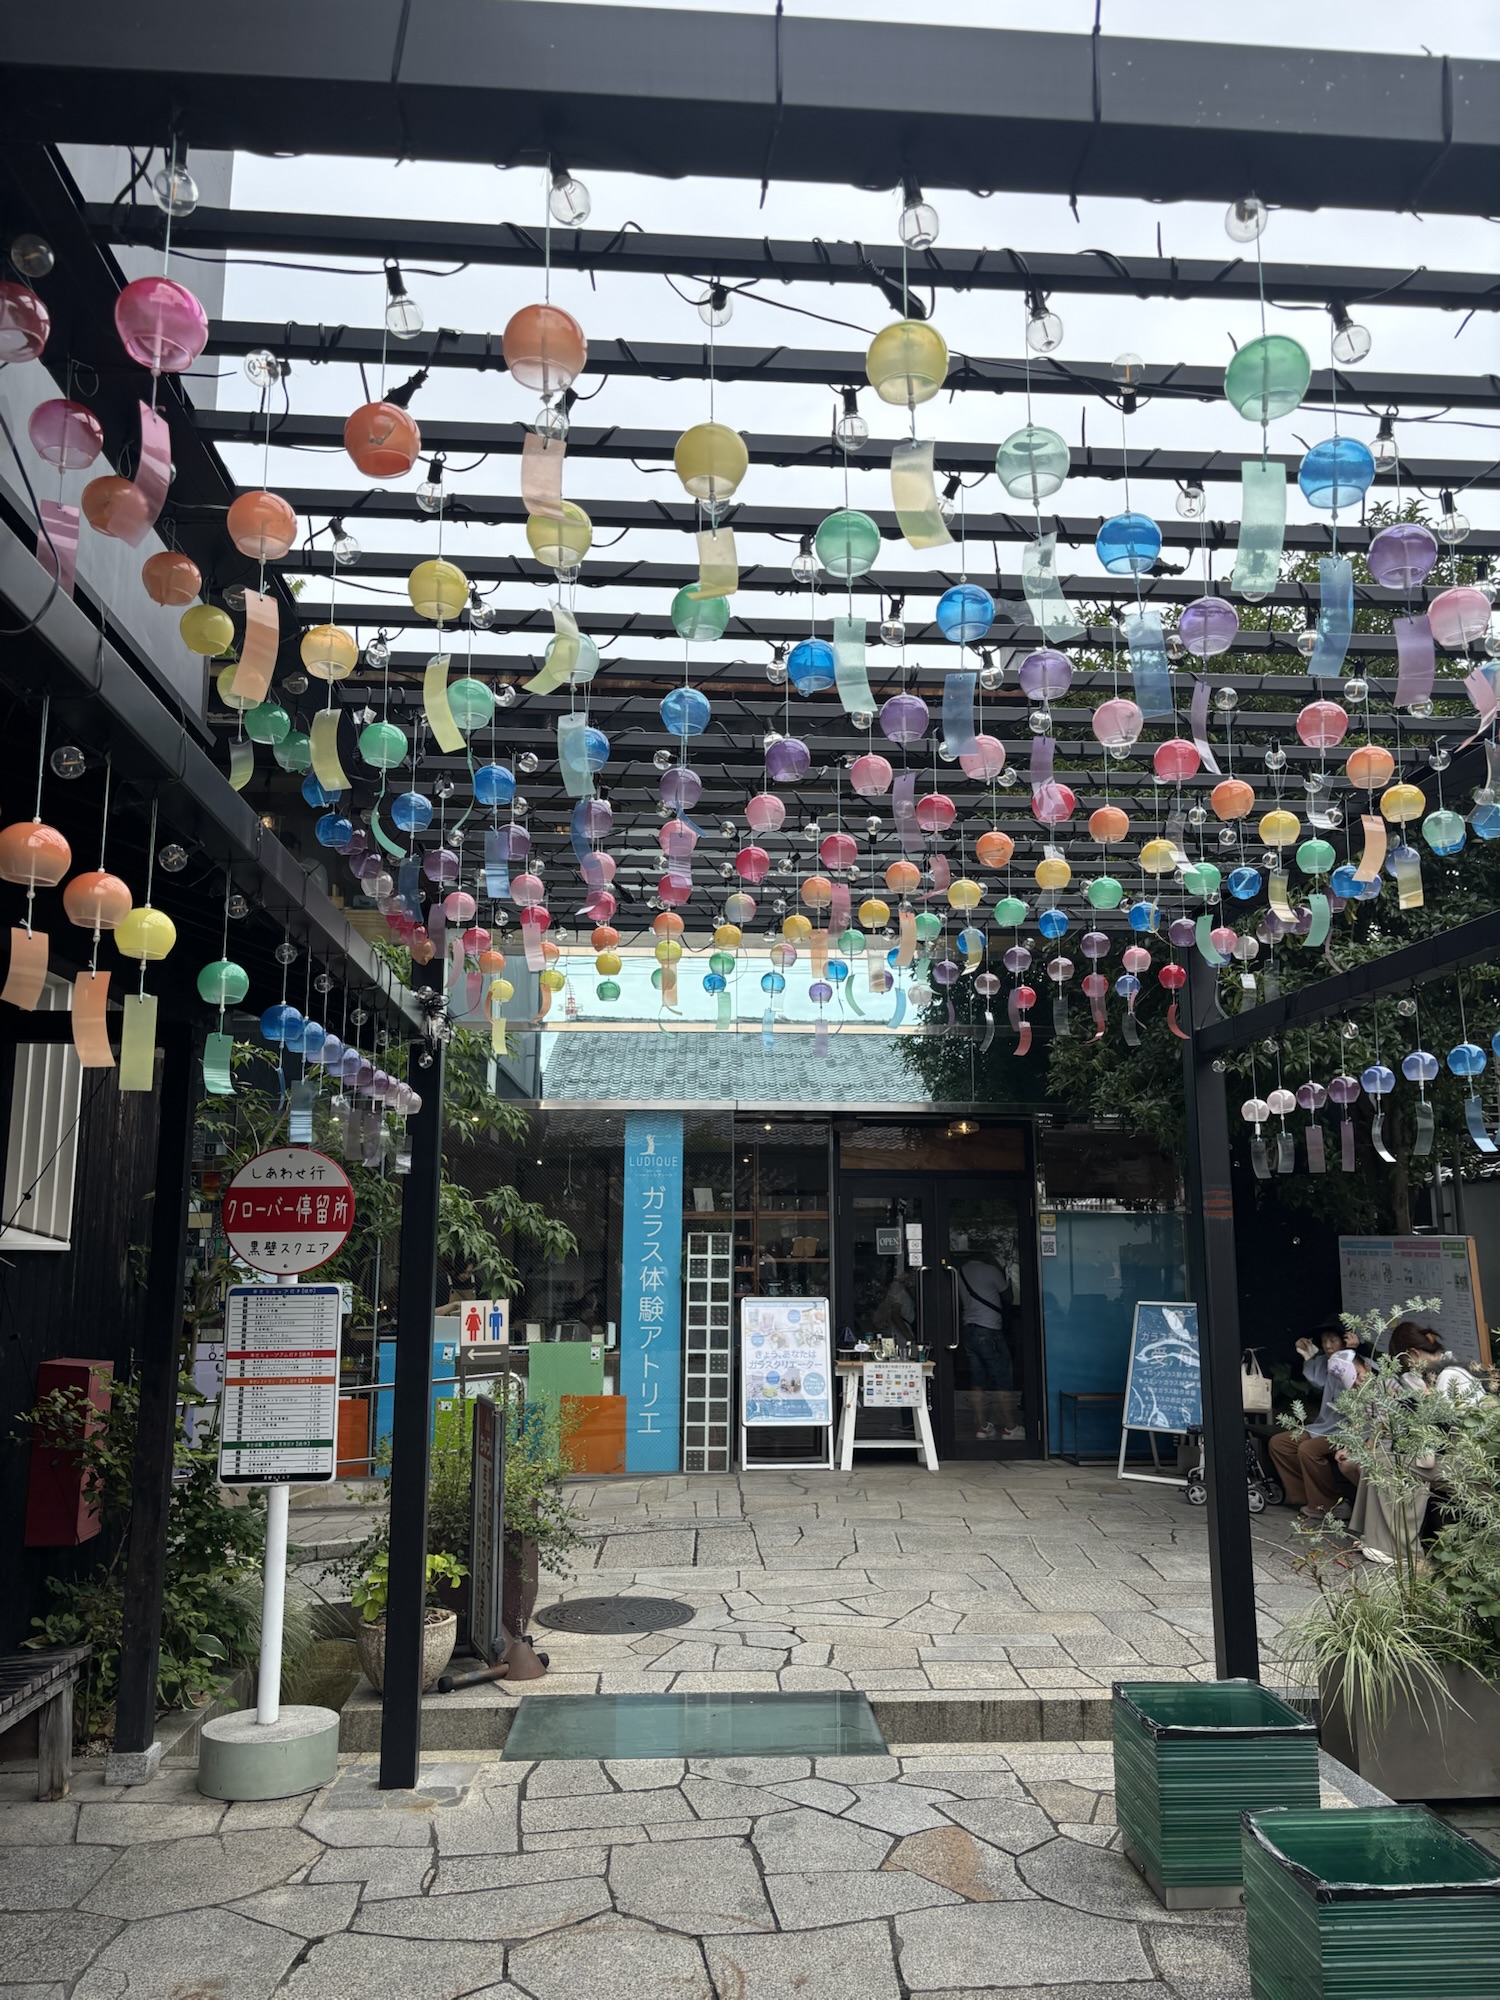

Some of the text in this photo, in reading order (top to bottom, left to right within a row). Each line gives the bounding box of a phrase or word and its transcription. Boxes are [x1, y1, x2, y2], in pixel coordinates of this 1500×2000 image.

[629, 1156, 678, 1167] LUDIQUE
[252, 1165, 326, 1180] しあわせ行
[228, 1194, 348, 1225] クローバー停留所
[248, 1240, 329, 1257] 黒壁スクエア
[879, 1237, 899, 1247] OPEN
[637, 1185, 666, 1434] ガラス体験アトリエ
